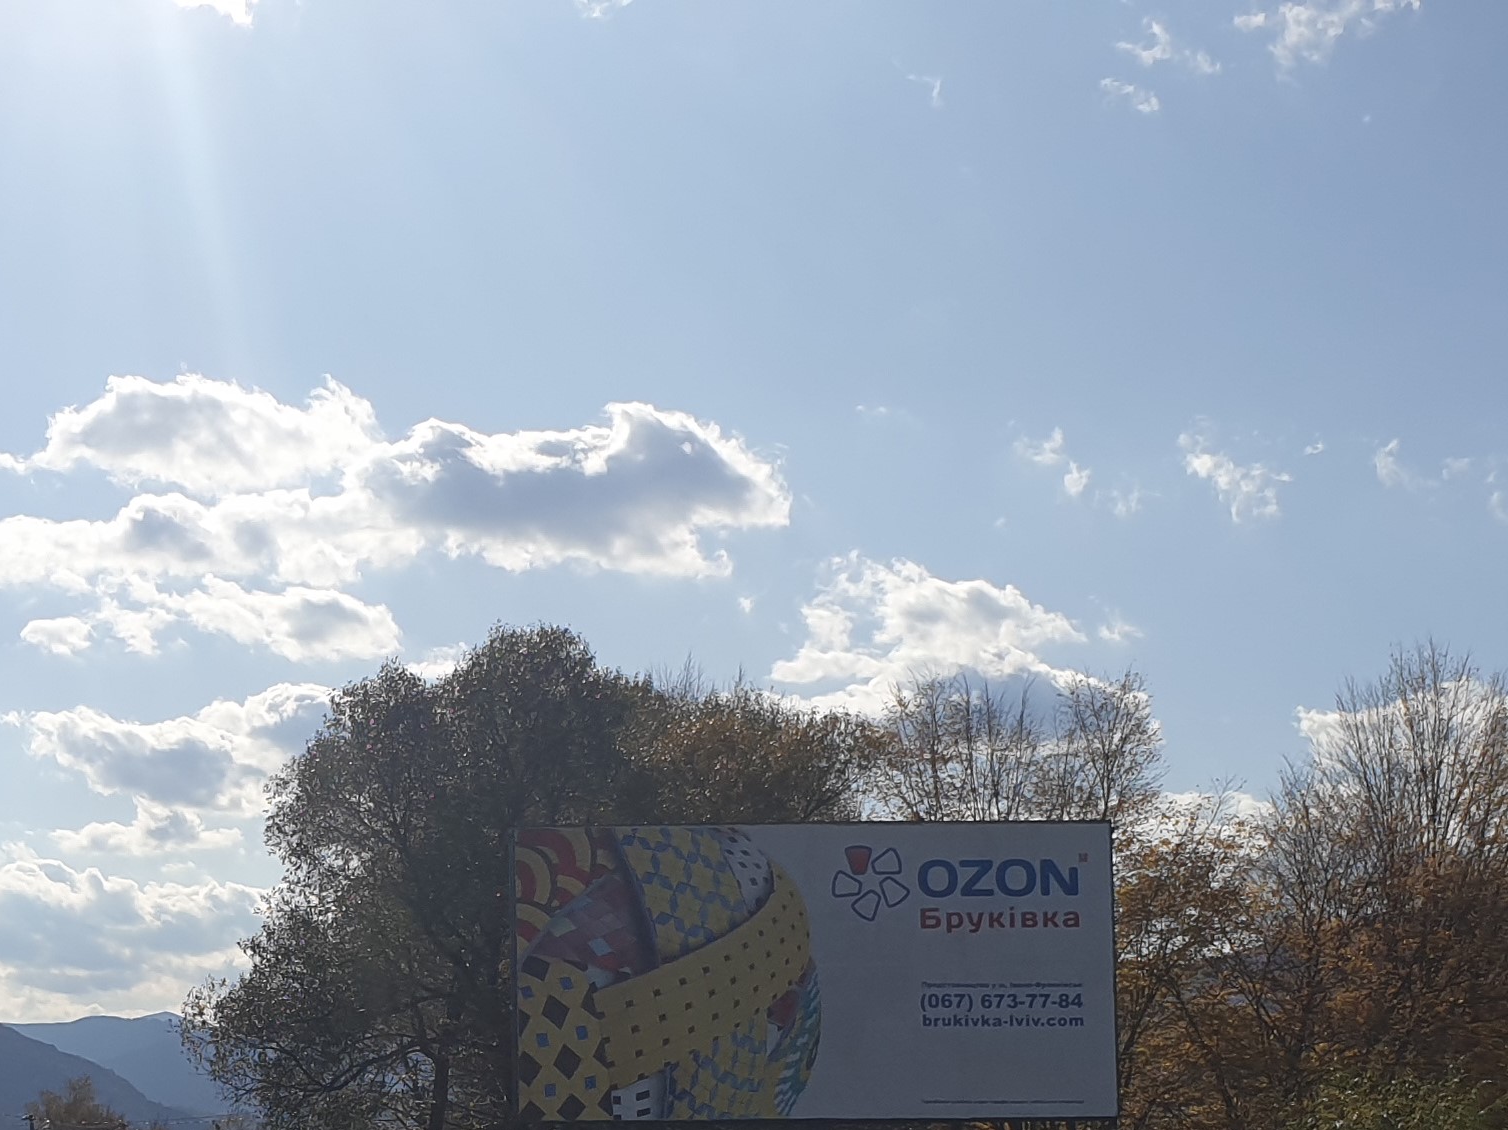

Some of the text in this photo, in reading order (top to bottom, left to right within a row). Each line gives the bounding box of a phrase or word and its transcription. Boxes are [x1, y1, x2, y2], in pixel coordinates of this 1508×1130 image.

[917, 859, 1079, 898] OZON
[920, 906, 1080, 933] Бруківка
[920, 993, 1083, 1012] (067) 673-77-84
[922, 1014, 1085, 1027] brukivka-lviv.com
